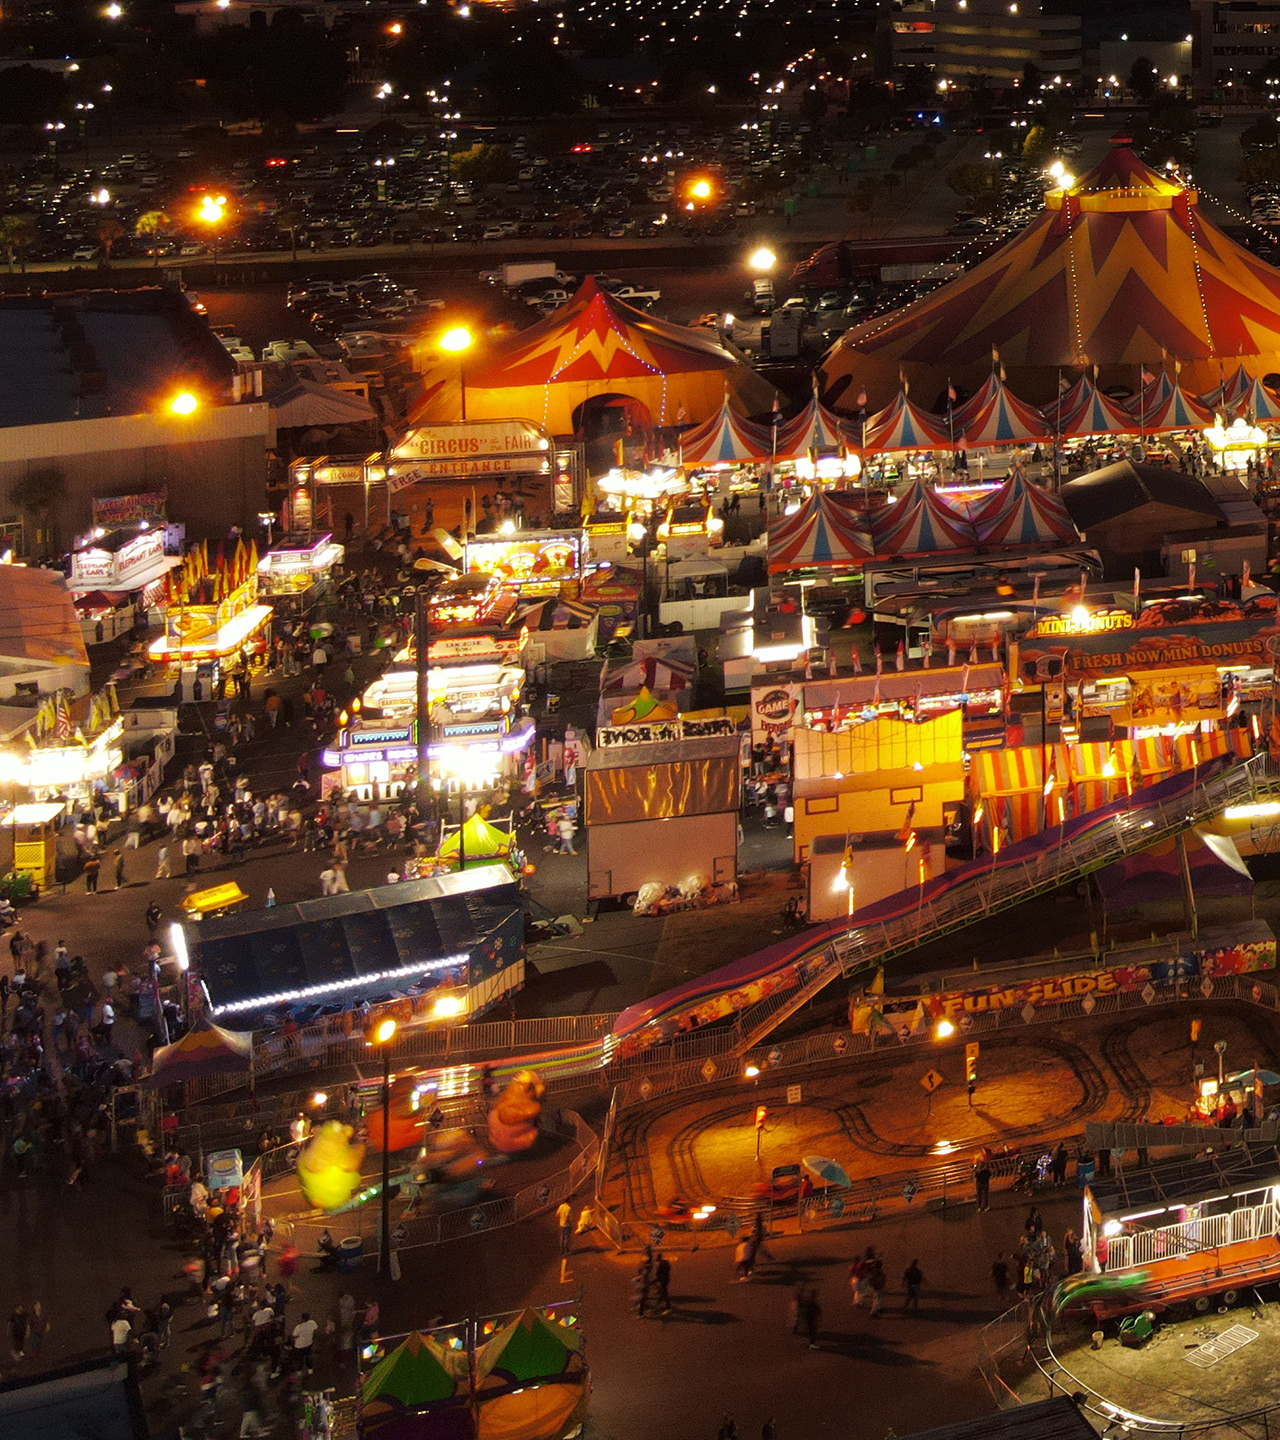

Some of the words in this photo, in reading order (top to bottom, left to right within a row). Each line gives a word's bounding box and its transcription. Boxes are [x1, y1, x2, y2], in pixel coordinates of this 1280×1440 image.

[505, 434, 532, 451] FAIR
[428, 460, 512, 473] ENTRANCE
[390, 468, 422, 492] FREE
[118, 551, 147, 571] ELEPHANT
[148, 543, 162, 559] EARS
[1073, 654, 1123, 670] FRESH
[1124, 649, 1163, 667] NOW
[1164, 646, 1201, 663] MINI
[1201, 638, 1263, 659] DONUTS
[461, 690, 479, 699] CORN
[479, 689, 496, 698] DOGS
[757, 698, 789, 714] GAME
[942, 987, 1015, 1017] FUN
[1026, 972, 1119, 1004] SLIDE
